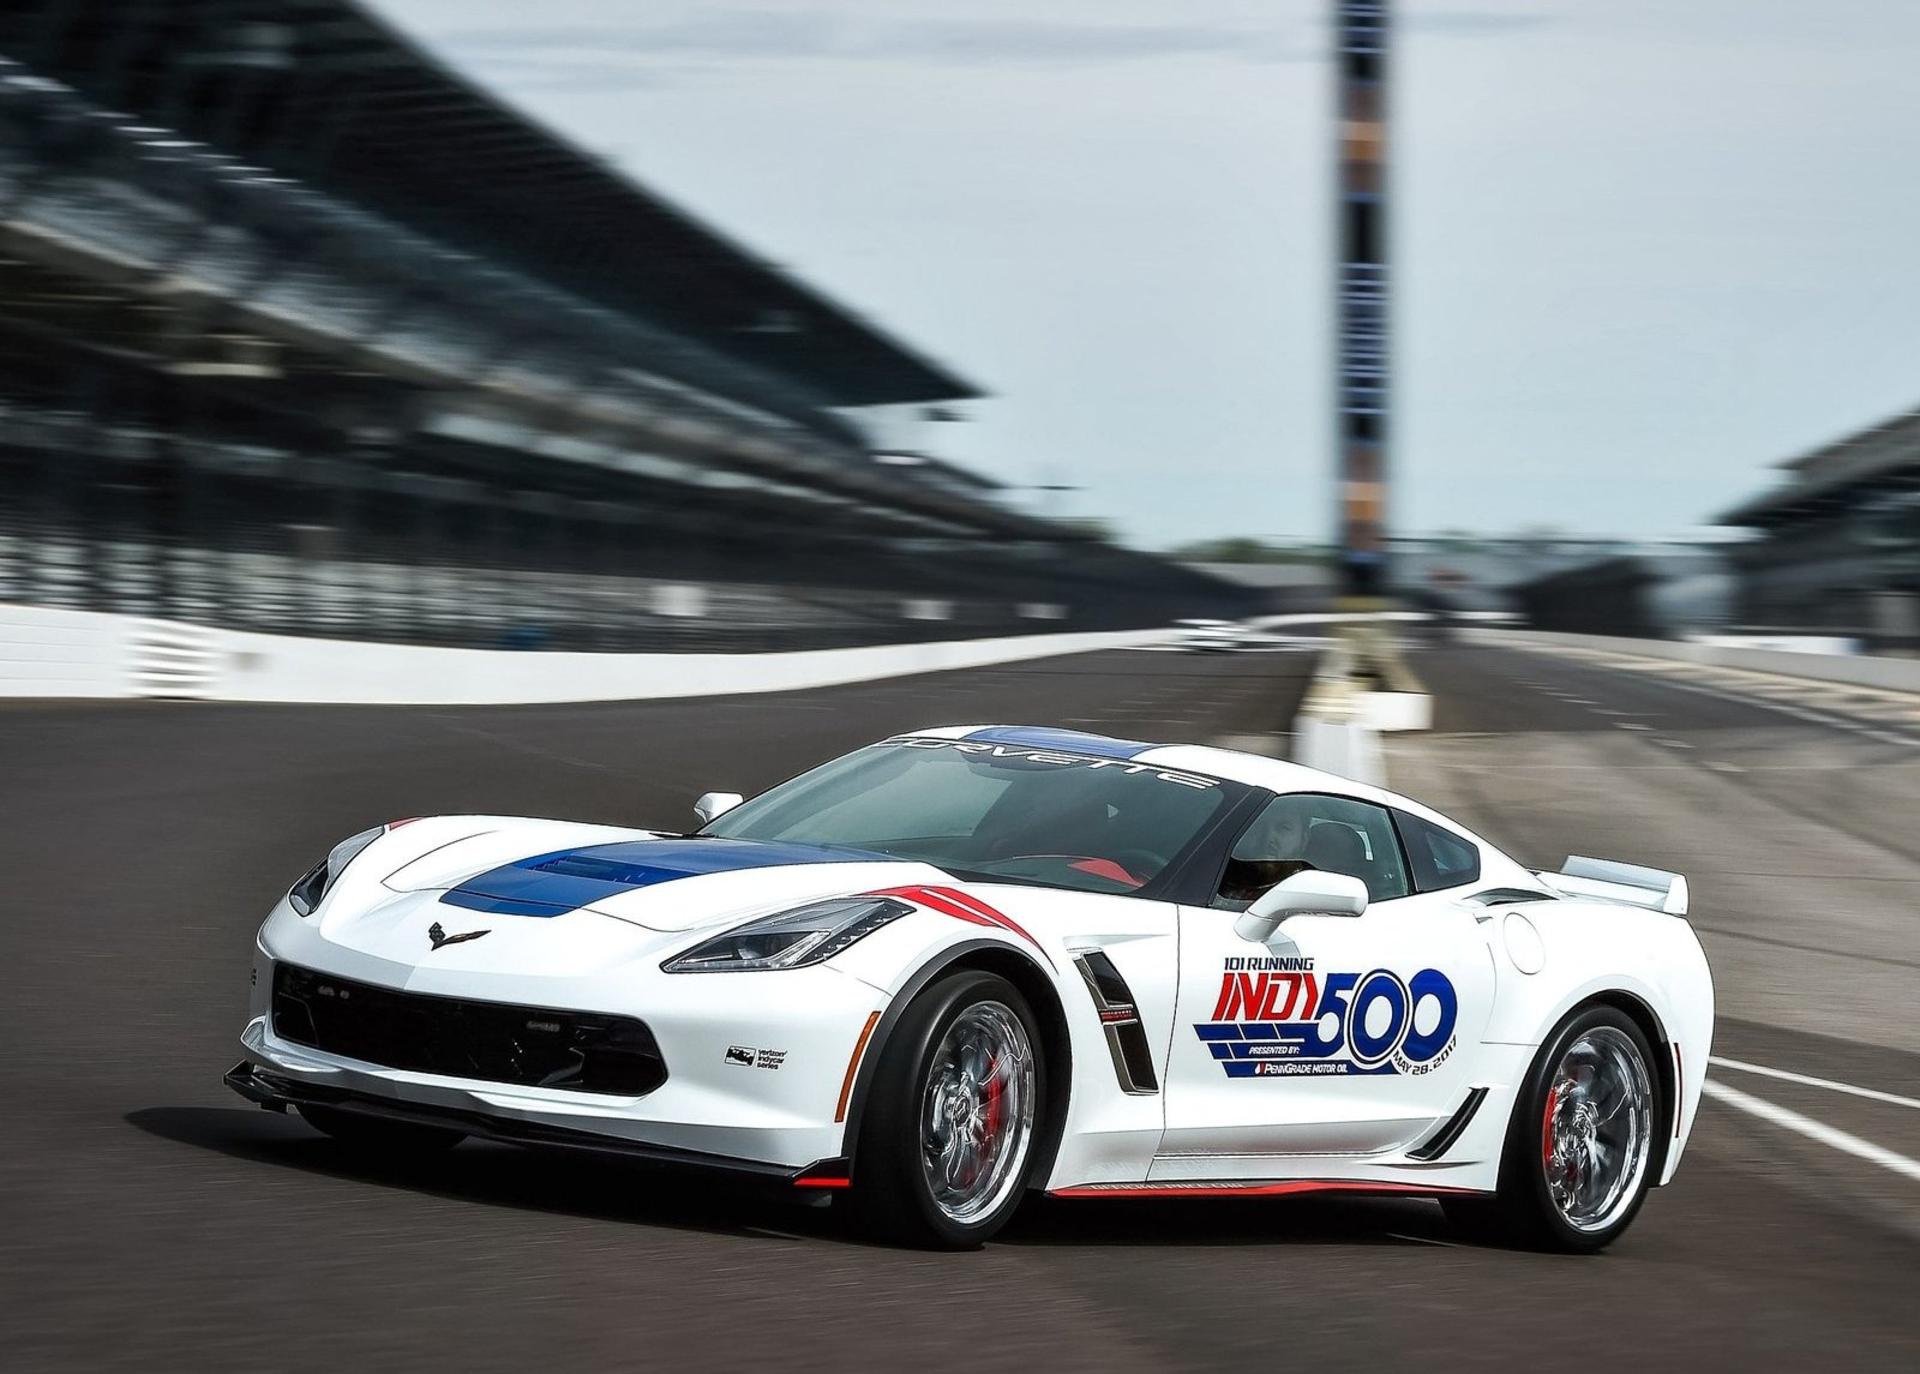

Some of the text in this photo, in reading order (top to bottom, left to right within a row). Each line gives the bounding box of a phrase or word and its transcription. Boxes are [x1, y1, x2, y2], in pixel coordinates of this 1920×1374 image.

[1247, 957, 1314, 971] RUNNING
[1211, 973, 1319, 1021] INDY
[1249, 1046, 1287, 1055] PRESENTED
[1393, 1049, 1412, 1073] MAY
[1432, 1035, 1457, 1069] 2017
[1312, 1063, 1336, 1073] MOTOR
[1336, 1063, 1348, 1073] OIL
